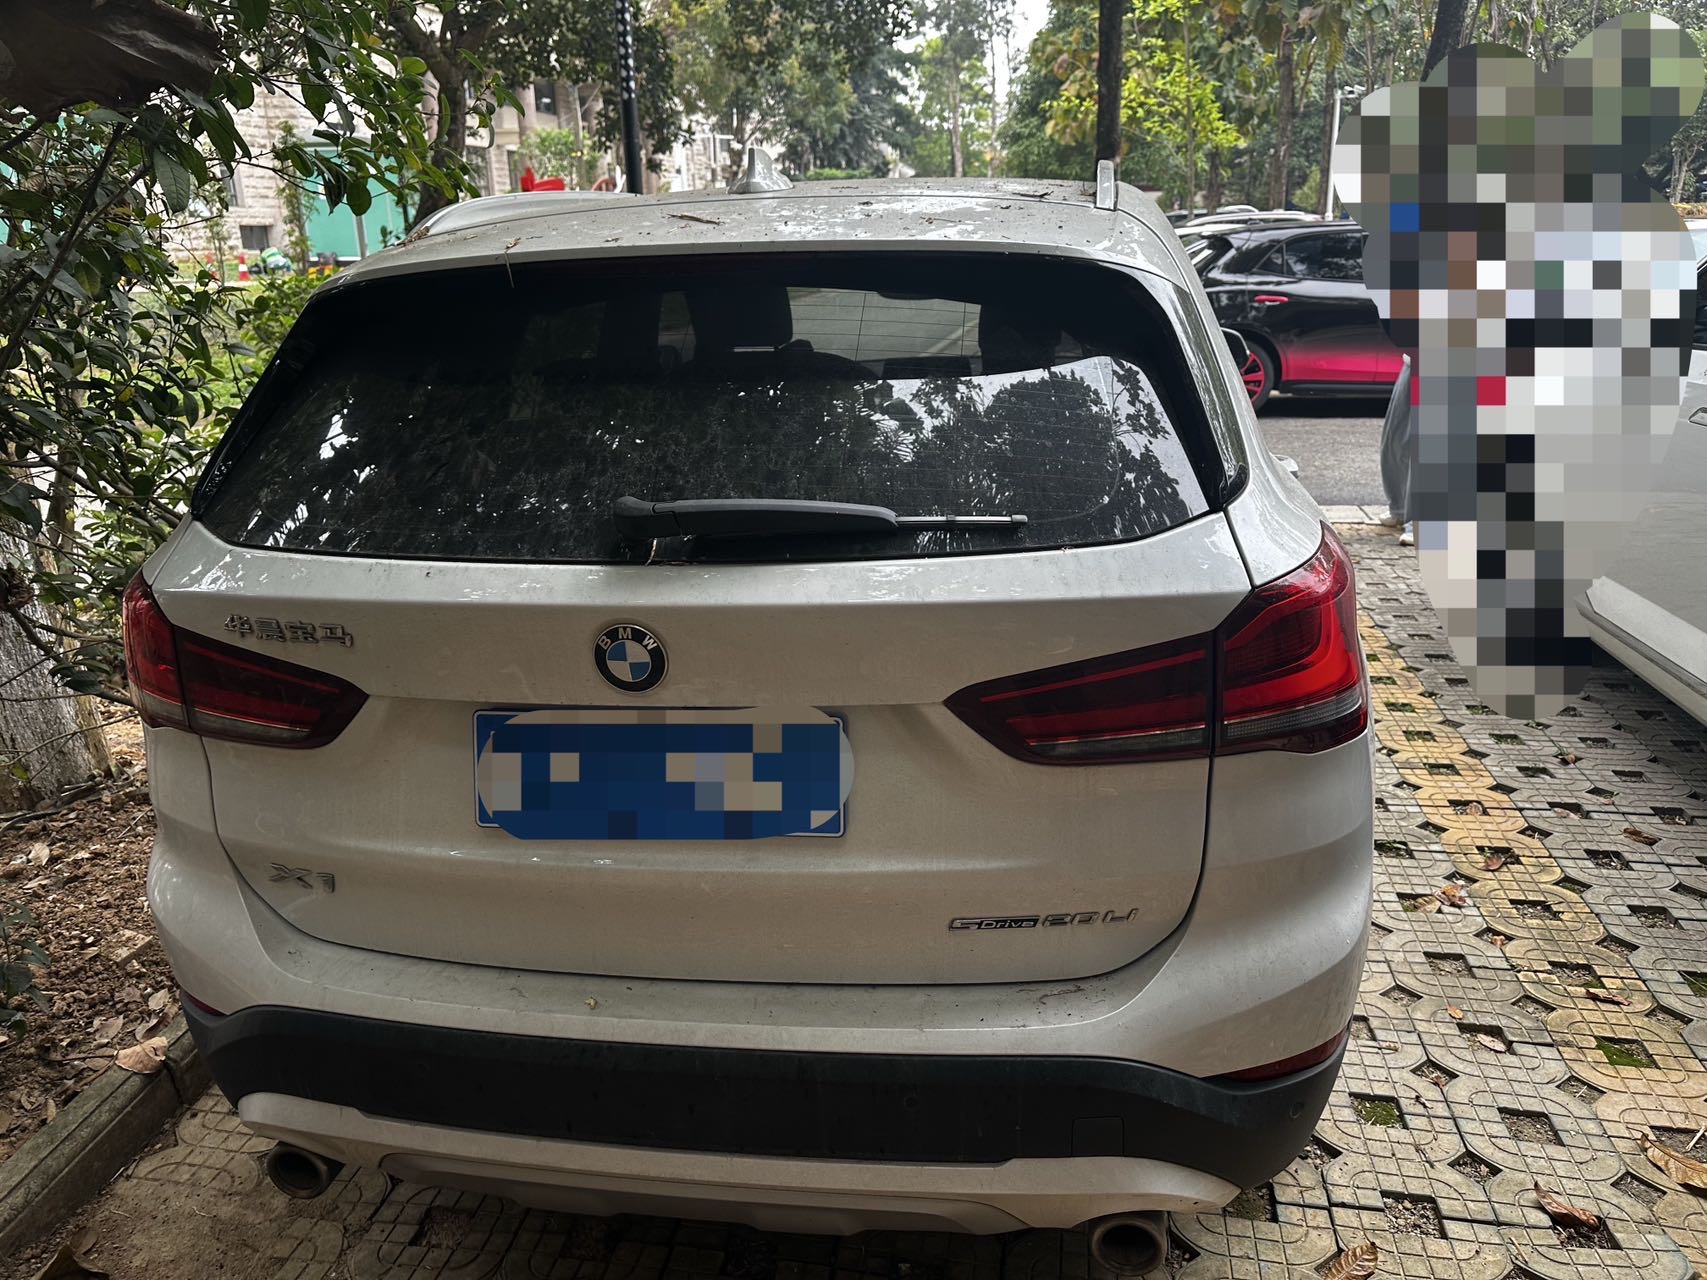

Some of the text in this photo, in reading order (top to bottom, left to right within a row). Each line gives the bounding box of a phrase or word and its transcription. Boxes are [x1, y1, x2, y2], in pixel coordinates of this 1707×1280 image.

[223, 613, 353, 648] 华晨宝马
[598, 627, 658, 651] BMW
[268, 863, 336, 893] X1
